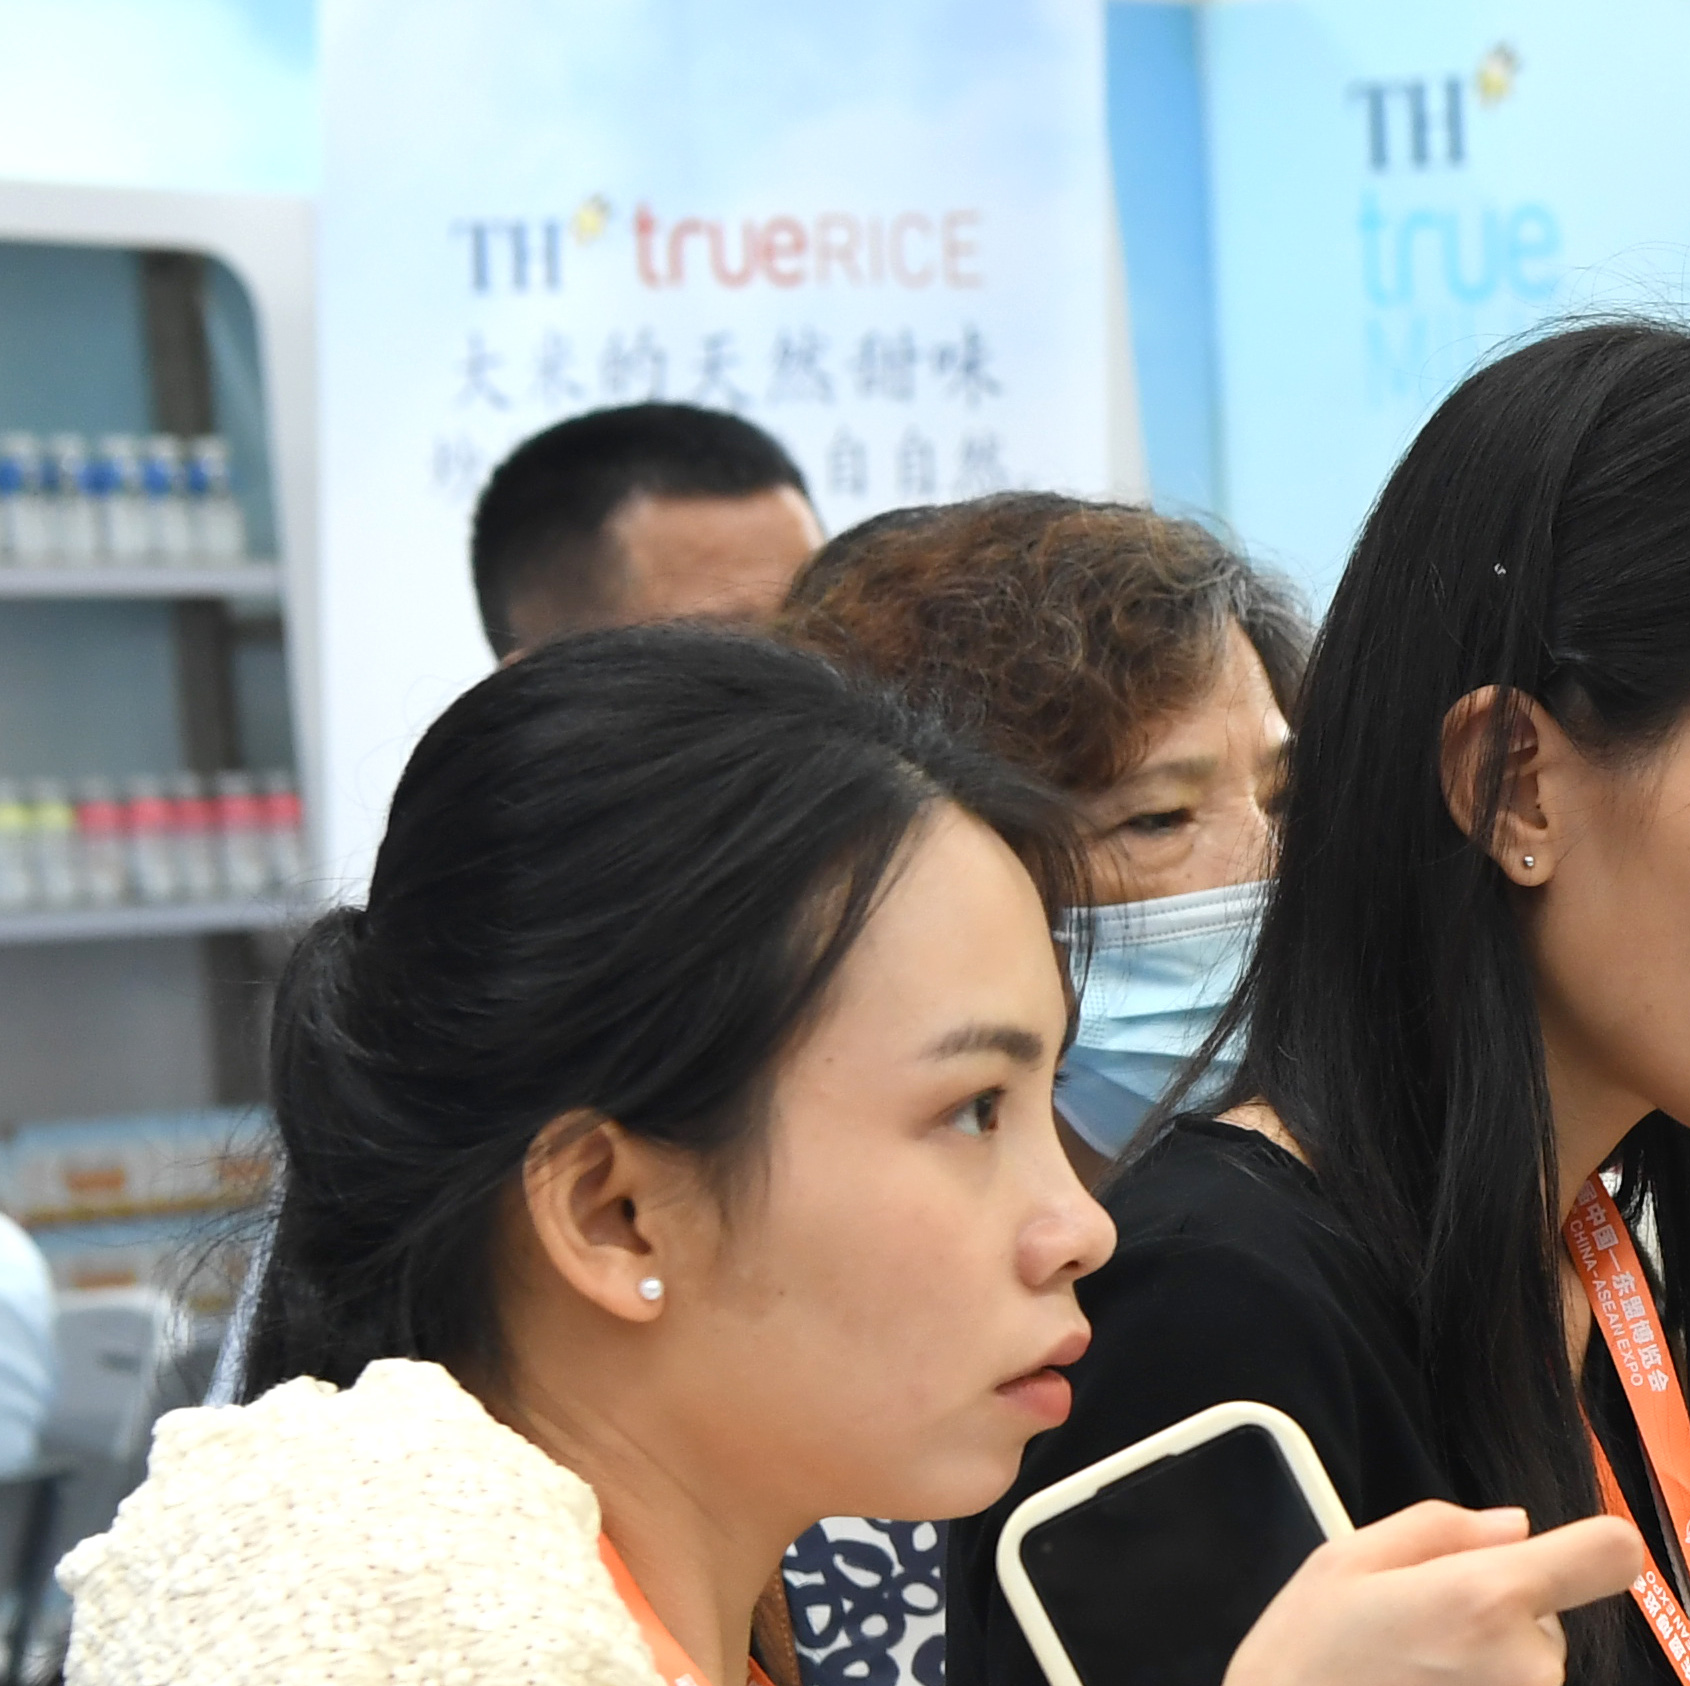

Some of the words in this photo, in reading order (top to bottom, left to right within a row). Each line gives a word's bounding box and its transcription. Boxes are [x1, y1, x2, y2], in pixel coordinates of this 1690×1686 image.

[1346, 75, 1466, 172] TH
[452, 215, 562, 293] TH
[1358, 192, 1562, 308] true
[1617, 1337, 1644, 1387] EXPO
[1646, 1570, 1677, 1617] EXPO
